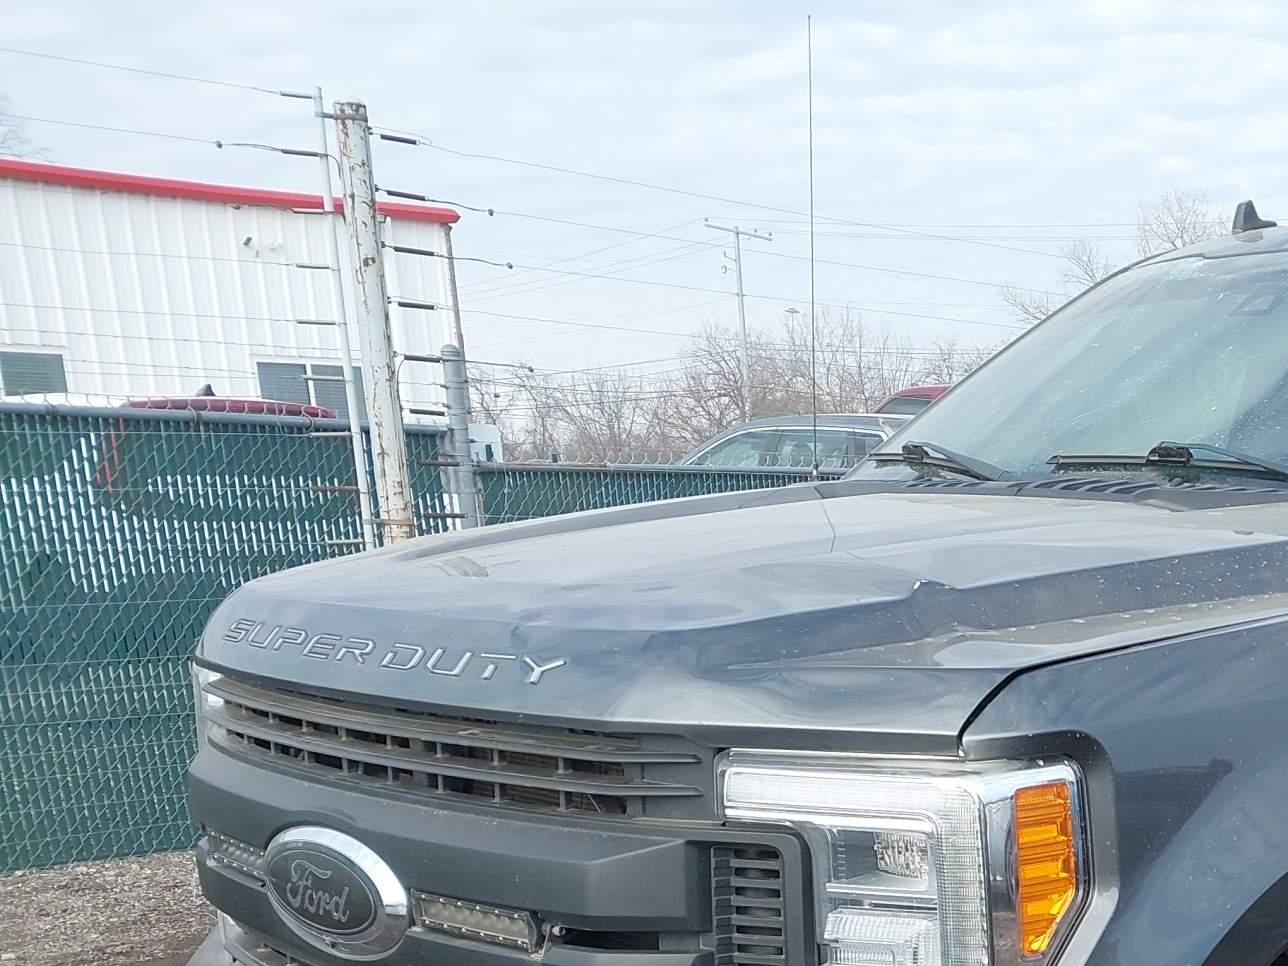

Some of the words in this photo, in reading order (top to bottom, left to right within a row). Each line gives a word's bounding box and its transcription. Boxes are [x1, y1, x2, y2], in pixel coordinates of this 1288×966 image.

[224, 617, 376, 664] SUPER
[380, 641, 569, 685] DUTY
[286, 859, 350, 923] Ford
